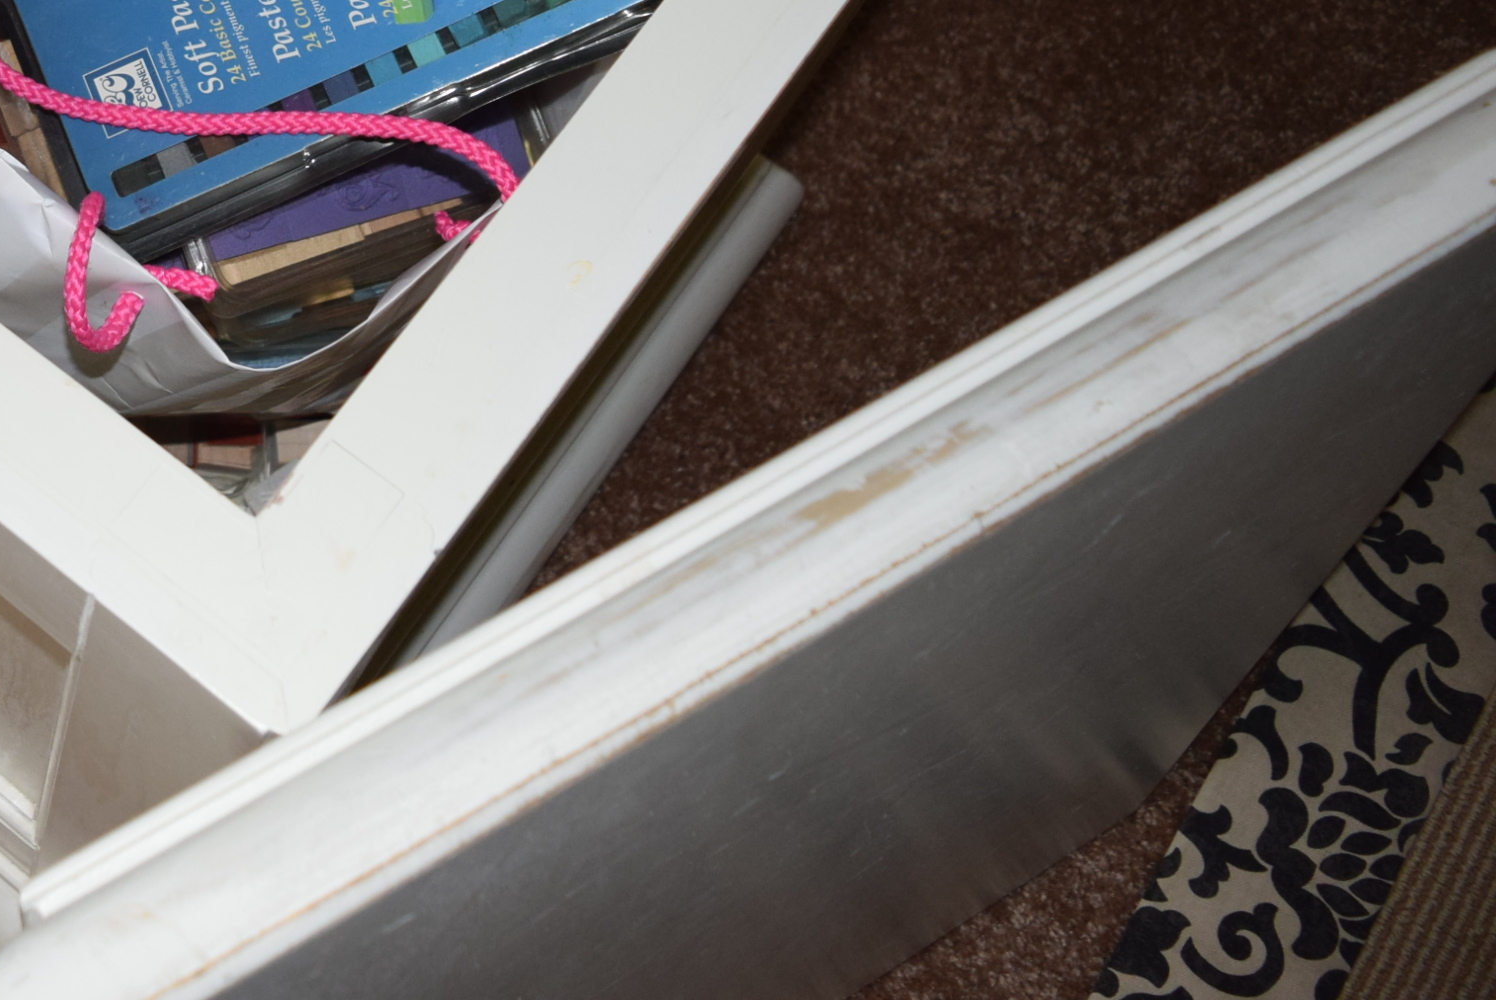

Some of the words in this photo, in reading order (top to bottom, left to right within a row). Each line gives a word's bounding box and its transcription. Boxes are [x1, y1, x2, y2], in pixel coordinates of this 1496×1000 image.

[220, 0, 250, 43] pigment
[323, 25, 337, 45] Les
[161, 39, 180, 68] Hobbyist
[210, 19, 237, 63] Basic
[302, 32, 323, 52] 24
[163, 69, 173, 82] The
[184, 40, 225, 95] Soft
[227, 65, 247, 85] 24
[239, 45, 261, 78] Finest
[132, 59, 158, 103] CORNELL
[168, 81, 185, 108] Serving
[175, 74, 193, 105] Ceramist
[132, 85, 149, 109] OEW
